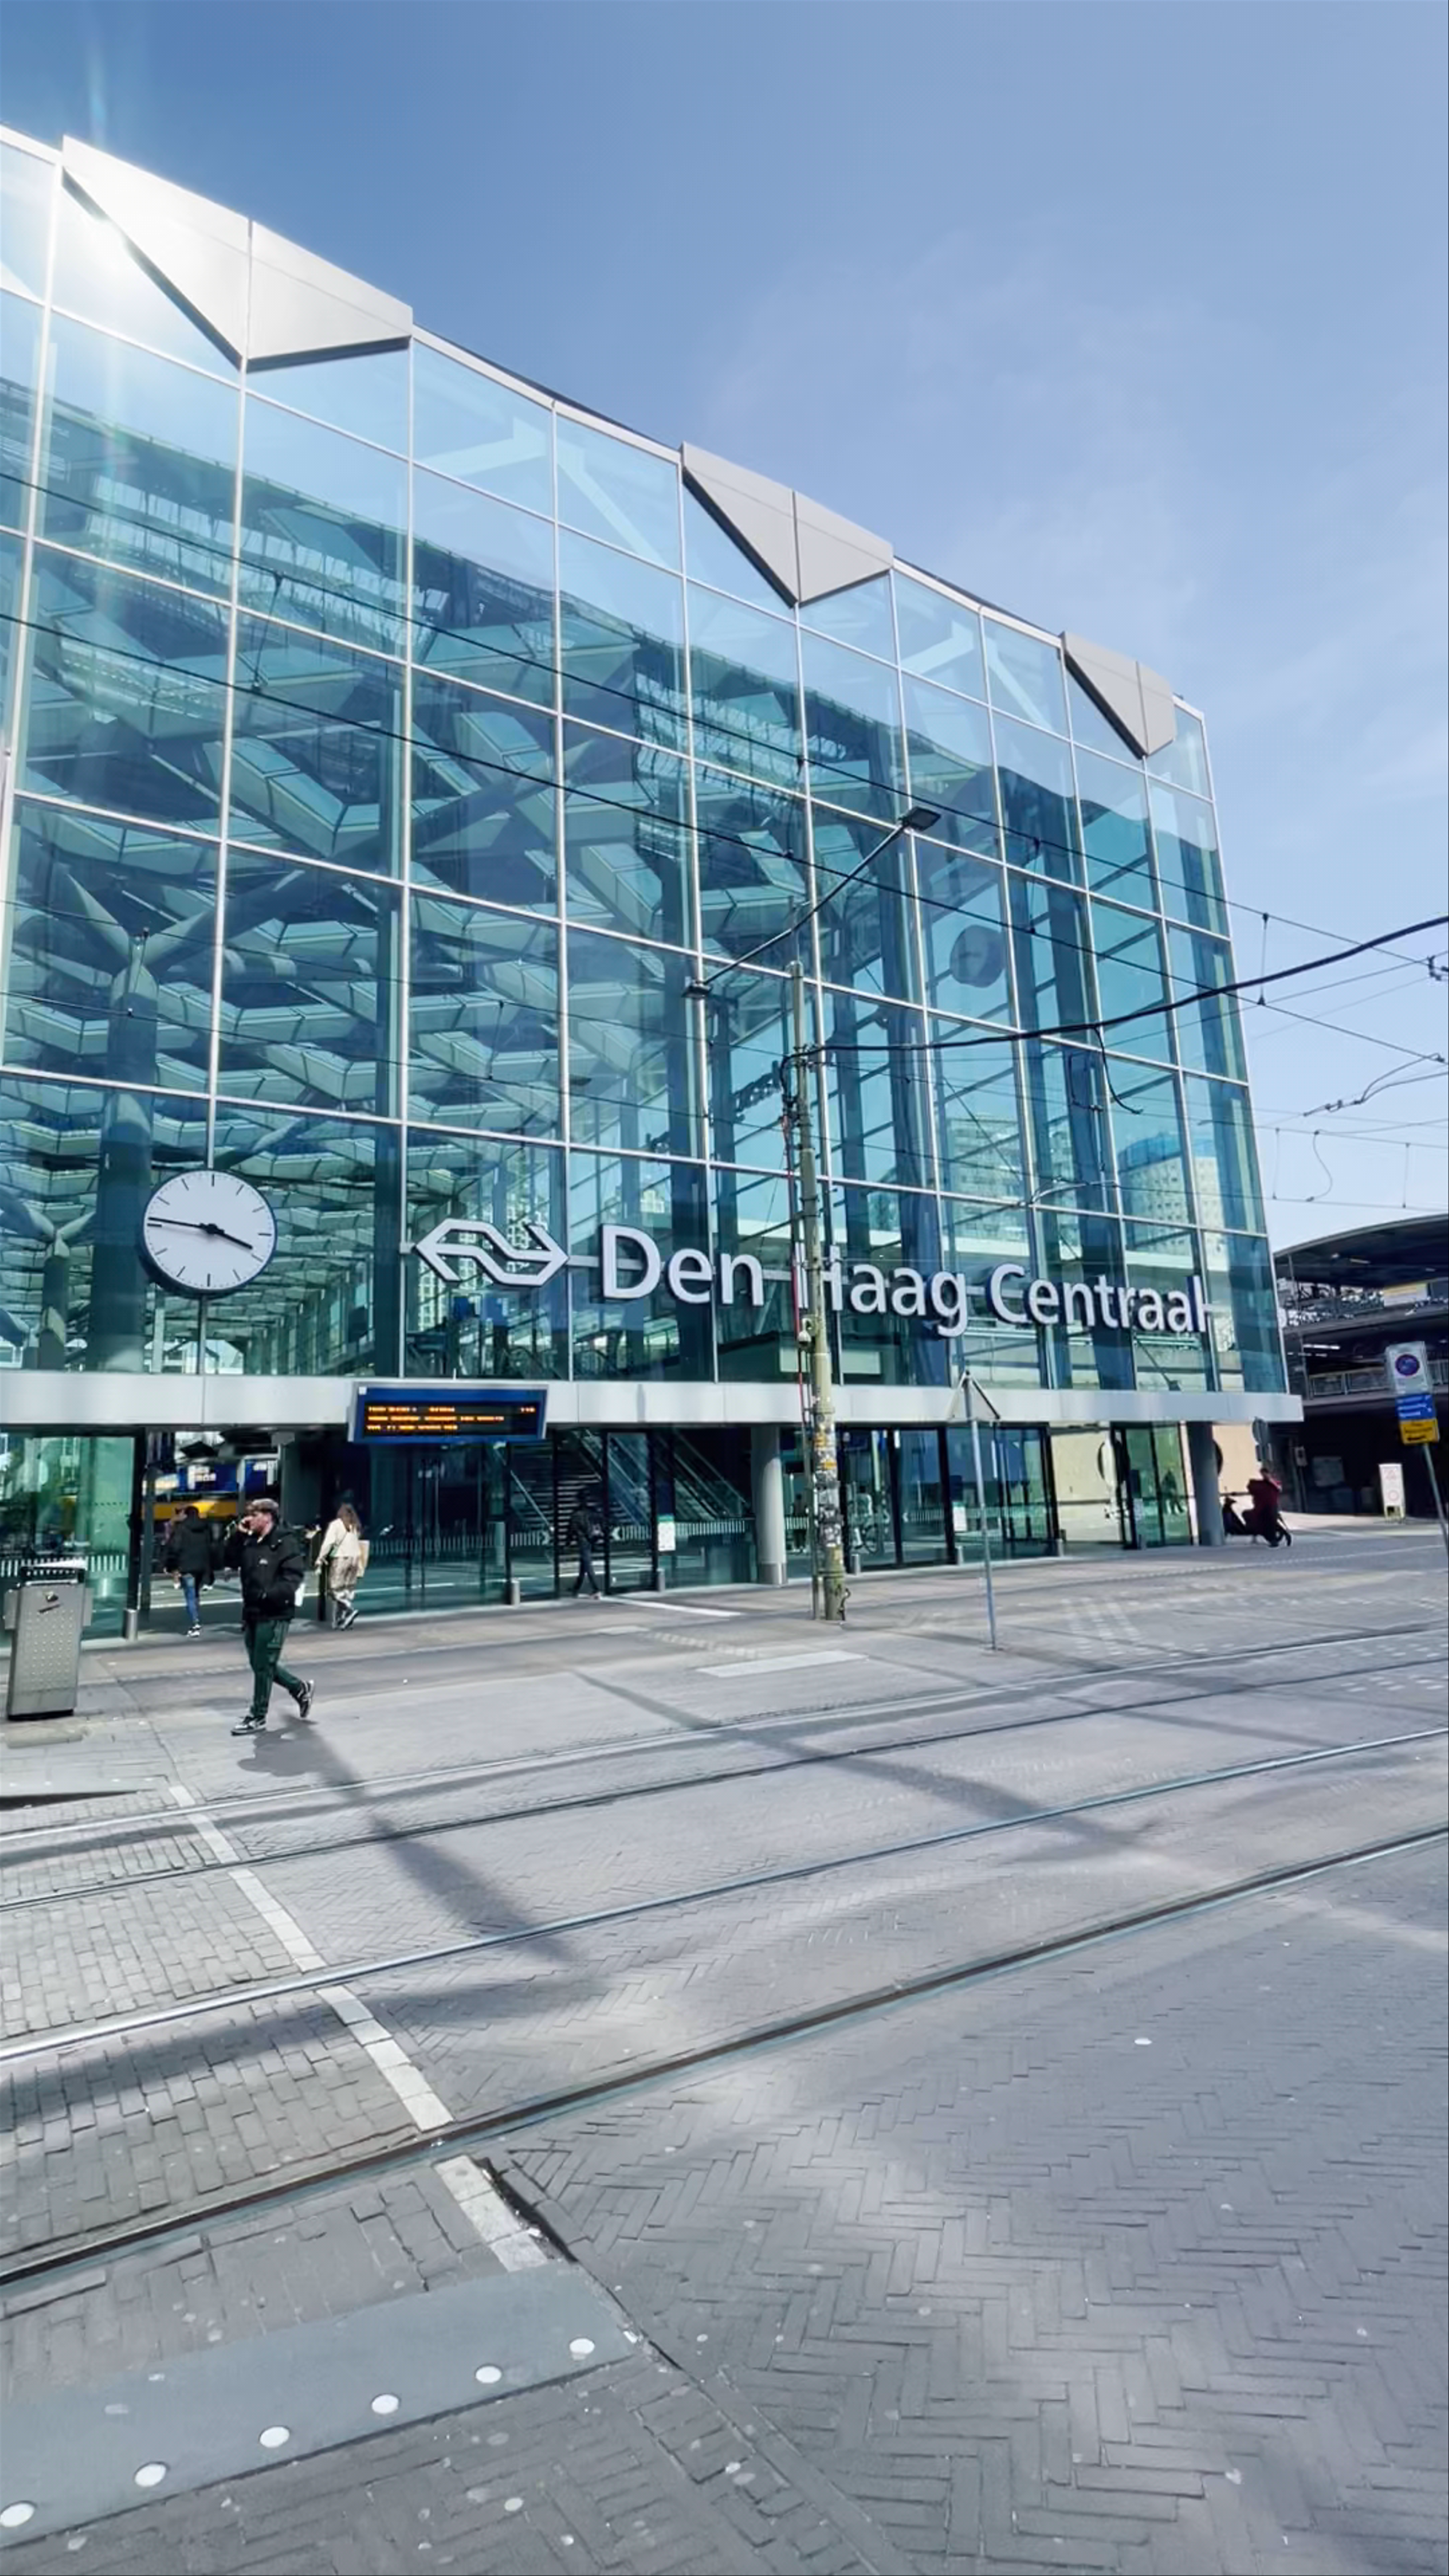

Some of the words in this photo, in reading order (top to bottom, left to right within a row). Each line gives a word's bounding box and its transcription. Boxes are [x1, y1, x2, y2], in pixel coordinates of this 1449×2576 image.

[602, 1224, 764, 1306] Den
[794, 1242, 968, 1338] Haag
[989, 1263, 1208, 1332] Centraal
